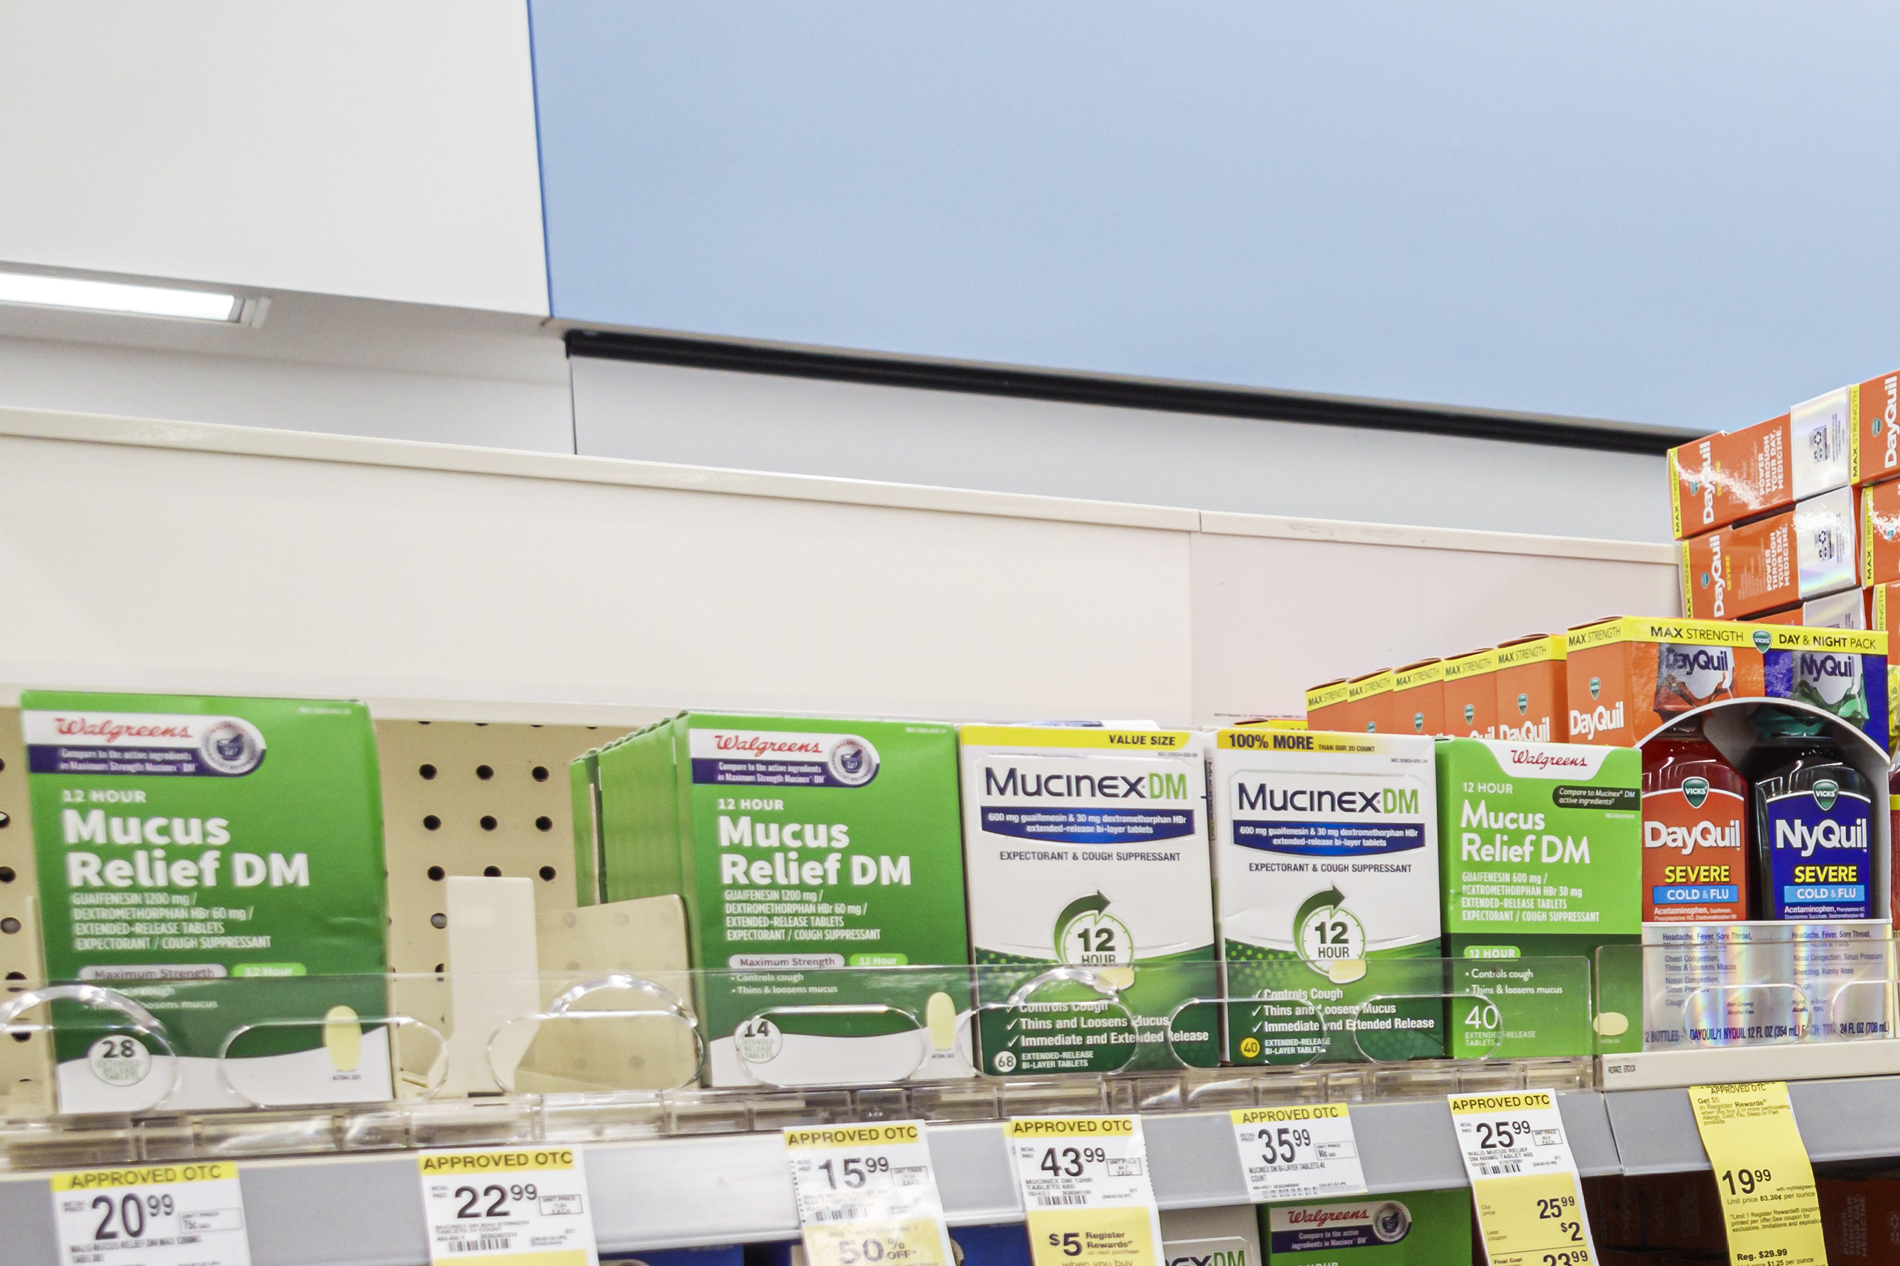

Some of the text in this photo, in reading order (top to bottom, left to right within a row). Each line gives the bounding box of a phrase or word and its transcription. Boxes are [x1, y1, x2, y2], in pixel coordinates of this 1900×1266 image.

[1884, 376, 1900, 468] DayQuil
[1651, 627, 1744, 643] MAX STRENGTH
[1779, 635, 1877, 650] DAY & NIGHT PACK
[55, 718, 193, 739] Walgreens
[715, 736, 823, 757] Walgreens
[1109, 735, 1176, 746] VALUE SIZE
[1229, 734, 1313, 750] 100% MORE
[1511, 749, 1588, 768] Walgreens
[62, 790, 146, 802] 12 HOUR
[1463, 783, 1513, 793] 12 HOUR
[718, 799, 784, 810] 12 HOUR
[1462, 801, 1545, 832] Mucus
[63, 810, 231, 844] Mucus
[719, 816, 850, 847] Mucus
[1644, 819, 1741, 855] DayQuil
[1775, 819, 1868, 856] NyQuil
[1462, 831, 1590, 864] Relief DM
[1000, 851, 1181, 863] EXPECTORANT & COUGH SUPPRESSANT
[66, 850, 310, 887] Relief DM
[722, 852, 911, 885] Relief DM
[1664, 866, 1730, 882] SEVERE
[1794, 865, 1858, 882] SEVERE
[725, 890, 817, 902] GUAIFENESIN 1200 mg
[1667, 888, 1700, 900] COLD
[1710, 888, 1729, 900] FLU
[726, 903, 816, 914] DEXTROMETHORPHAN
[834, 903, 846, 914] 60
[727, 916, 844, 927] EXTENDED-RELEASE TABLETS
[727, 929, 881, 940] EXPECTORANT COUGH SUPPRESSANT
[740, 957, 835, 968] Maximum Strength
[424, 1152, 573, 1170] APPROVED OTC
[1737, 1248, 1788, 1261] Reg. $29.99
